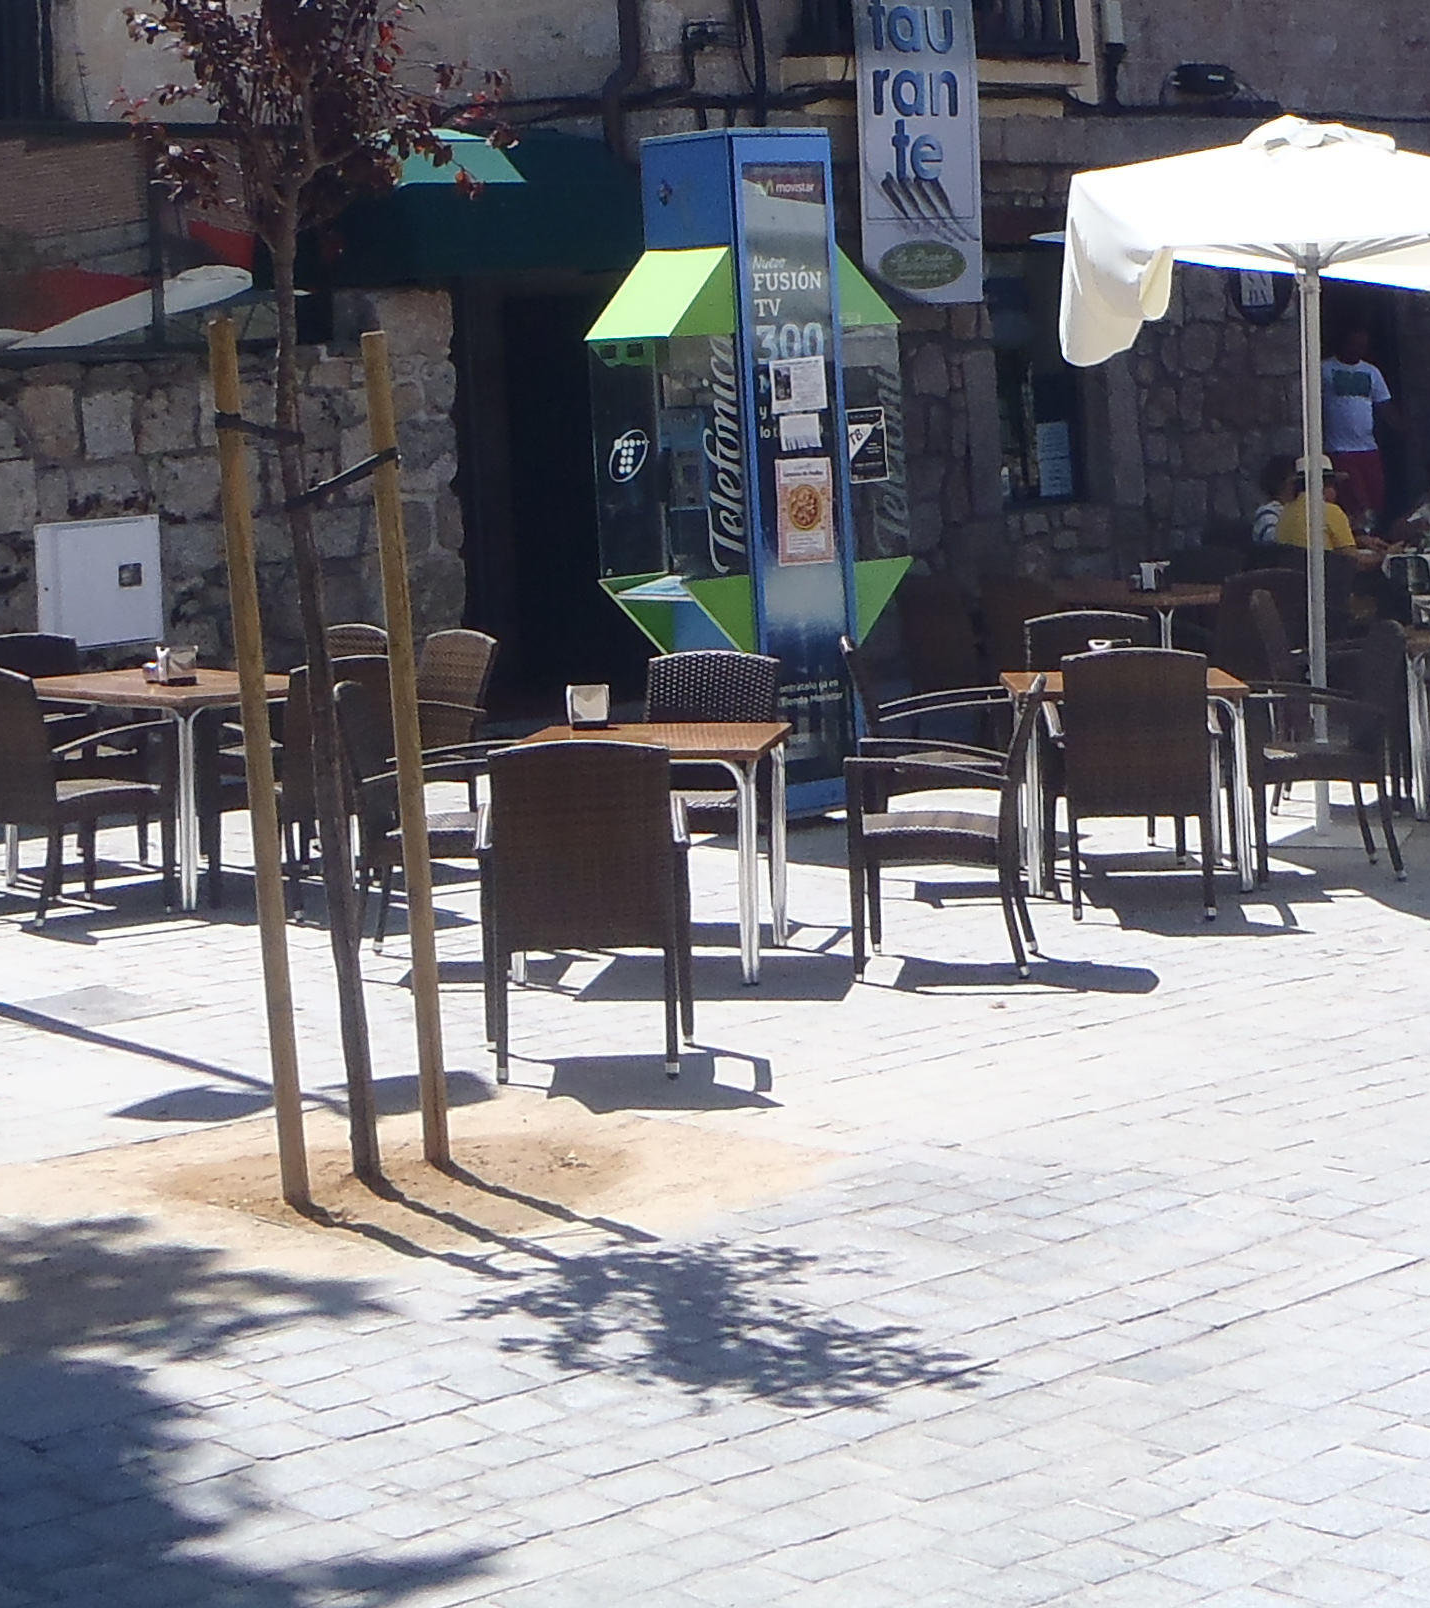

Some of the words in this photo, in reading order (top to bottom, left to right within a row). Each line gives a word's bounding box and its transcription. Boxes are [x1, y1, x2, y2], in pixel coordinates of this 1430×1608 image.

[871, 68, 959, 117] ran
[891, 118, 944, 181] te
[752, 265, 823, 291] FUSIÓN
[753, 297, 782, 318] TV
[755, 322, 825, 365] 300
